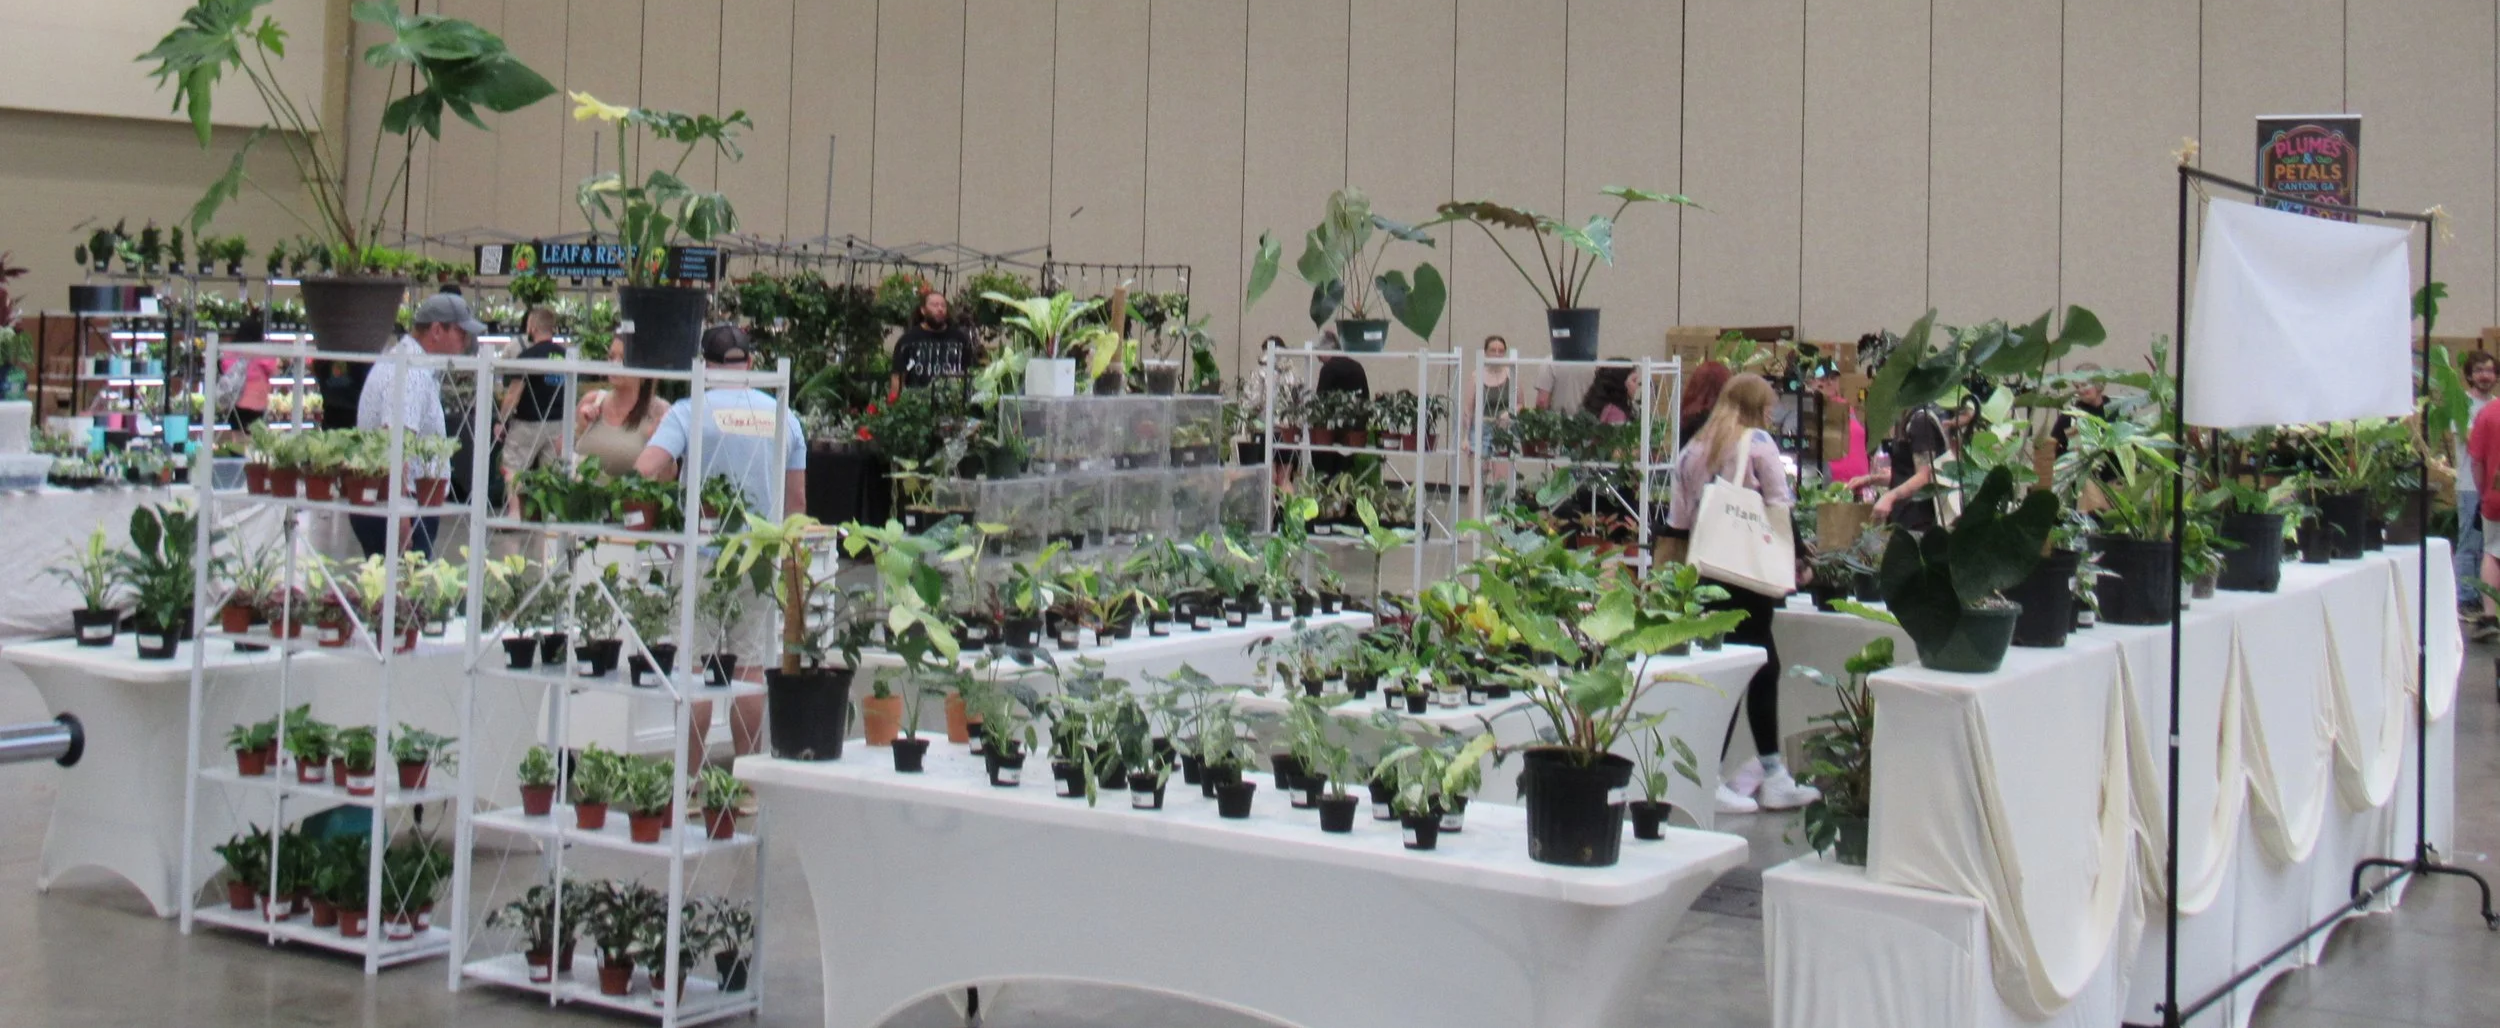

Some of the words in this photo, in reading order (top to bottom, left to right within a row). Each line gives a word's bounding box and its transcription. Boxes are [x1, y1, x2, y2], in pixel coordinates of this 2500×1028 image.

[2275, 136, 2341, 158] PLUMES
[2303, 152, 2312, 164] &
[2275, 164, 2341, 180] PETALS
[2278, 182, 2318, 191] CANTON,
[2321, 182, 2334, 191] GA
[542, 244, 580, 264] LEAF
[582, 246, 592, 264] &
